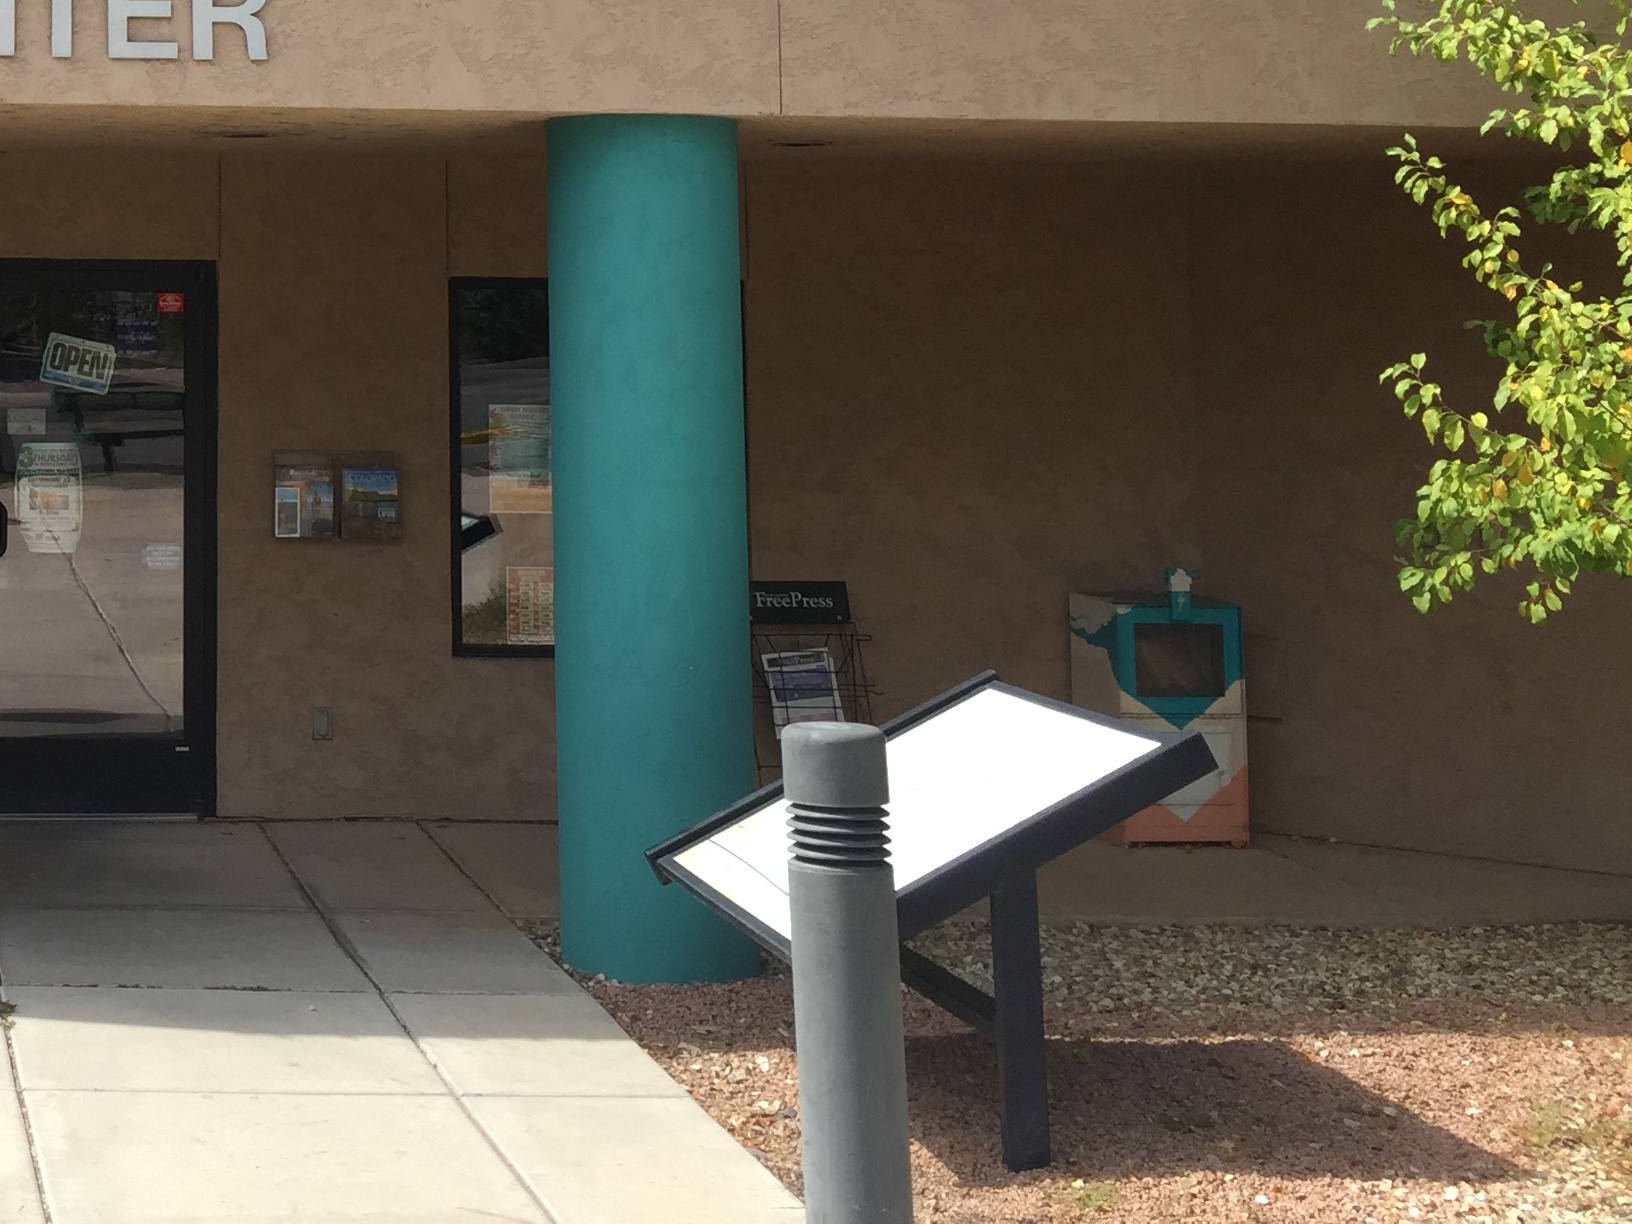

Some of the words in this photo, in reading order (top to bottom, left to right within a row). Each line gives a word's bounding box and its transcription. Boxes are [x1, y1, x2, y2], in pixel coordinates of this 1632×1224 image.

[49, 342, 110, 382] OPEN
[348, 473, 396, 482] COLORADO
[754, 591, 834, 608] FreePress
